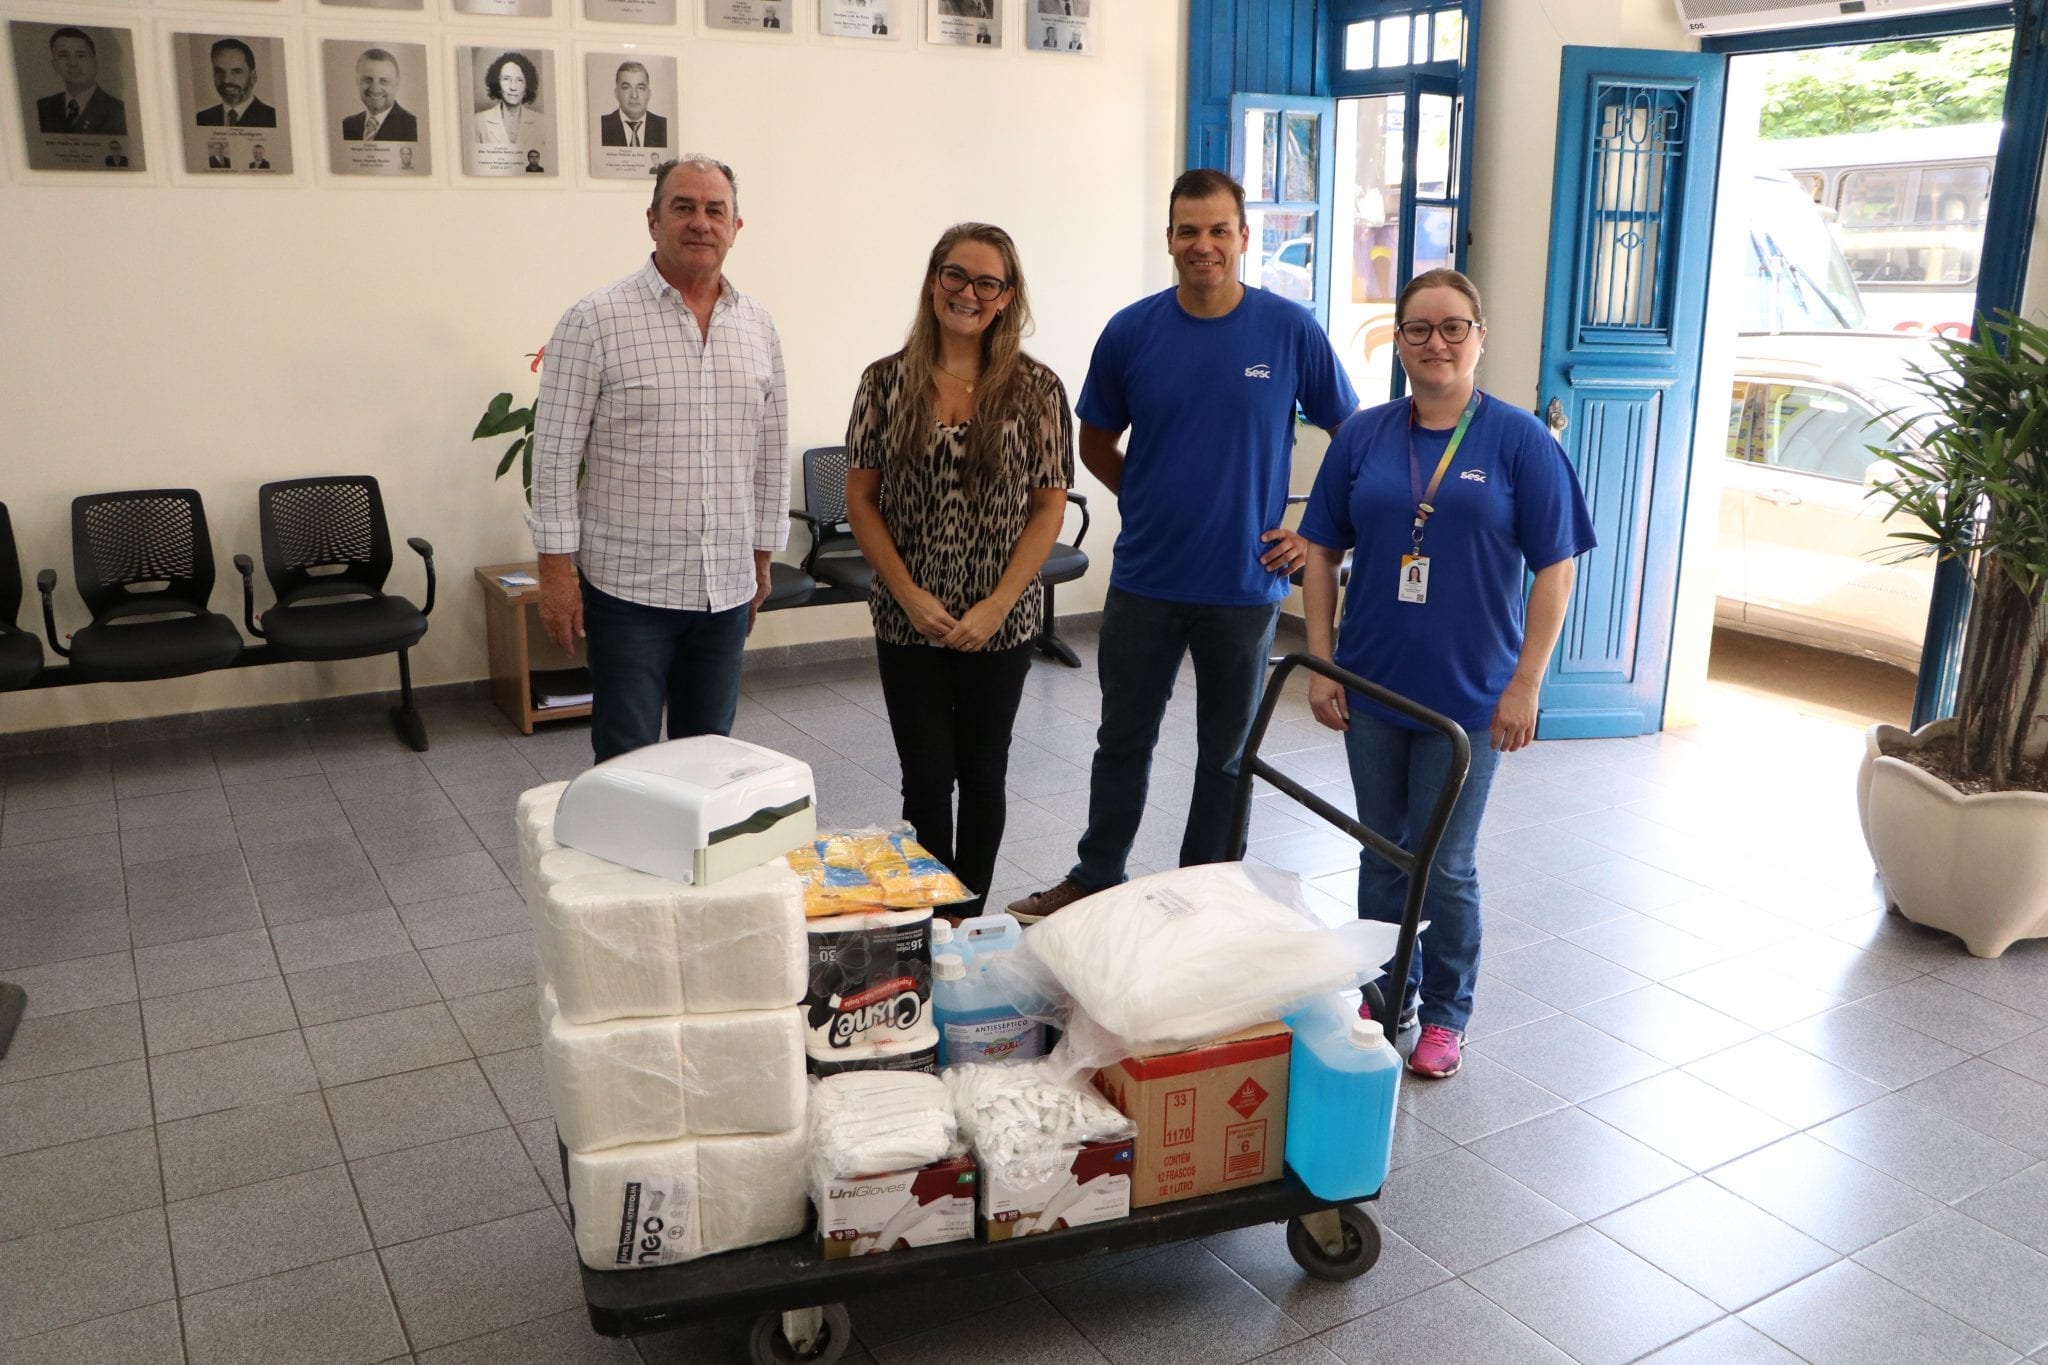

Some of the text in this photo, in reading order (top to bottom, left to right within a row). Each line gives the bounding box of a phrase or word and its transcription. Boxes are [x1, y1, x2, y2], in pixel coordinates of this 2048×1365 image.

[911, 938, 924, 951] 16
[819, 950, 838, 962] 30
[835, 990, 922, 1045] Cisne
[1174, 1093, 1187, 1107] 33
[1166, 1127, 1191, 1142] 1170
[1241, 1140, 1250, 1152] 6
[1166, 1165, 1196, 1180] FRASCOS
[829, 1183, 906, 1200] UniGloves
[1159, 1185, 1169, 1197] DE
[1174, 1180, 1193, 1195] LITRO
